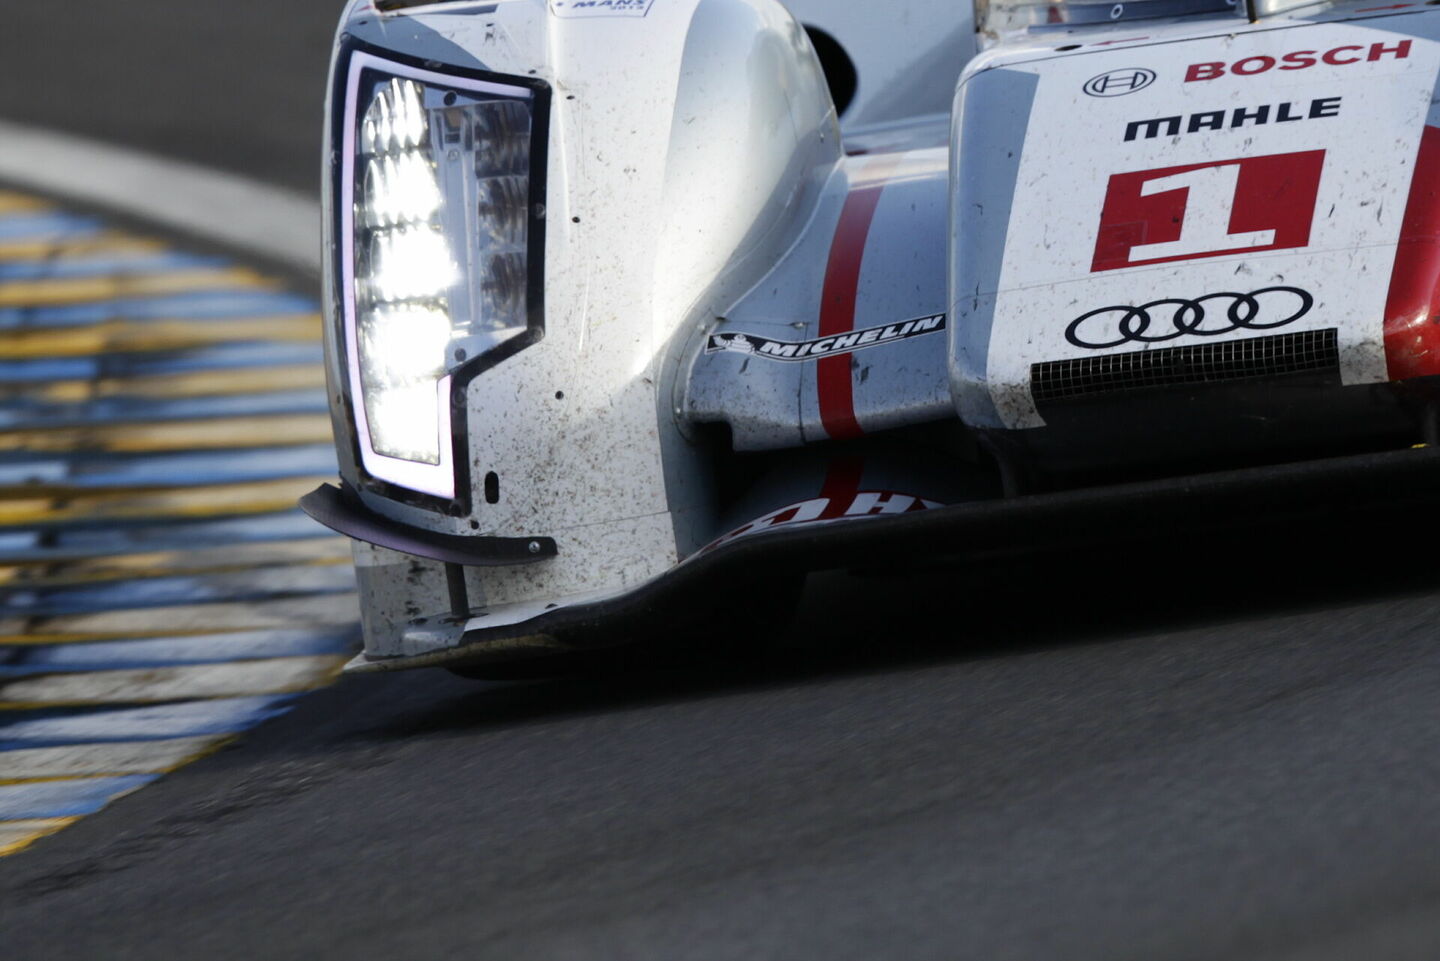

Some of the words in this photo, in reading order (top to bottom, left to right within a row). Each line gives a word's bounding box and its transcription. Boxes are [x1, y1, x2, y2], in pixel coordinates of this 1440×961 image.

[1183, 38, 1413, 83] BOSCH
[1122, 95, 1343, 142] MAHLE
[1127, 163, 1278, 264] 1
[759, 315, 944, 358] MICHELIN
